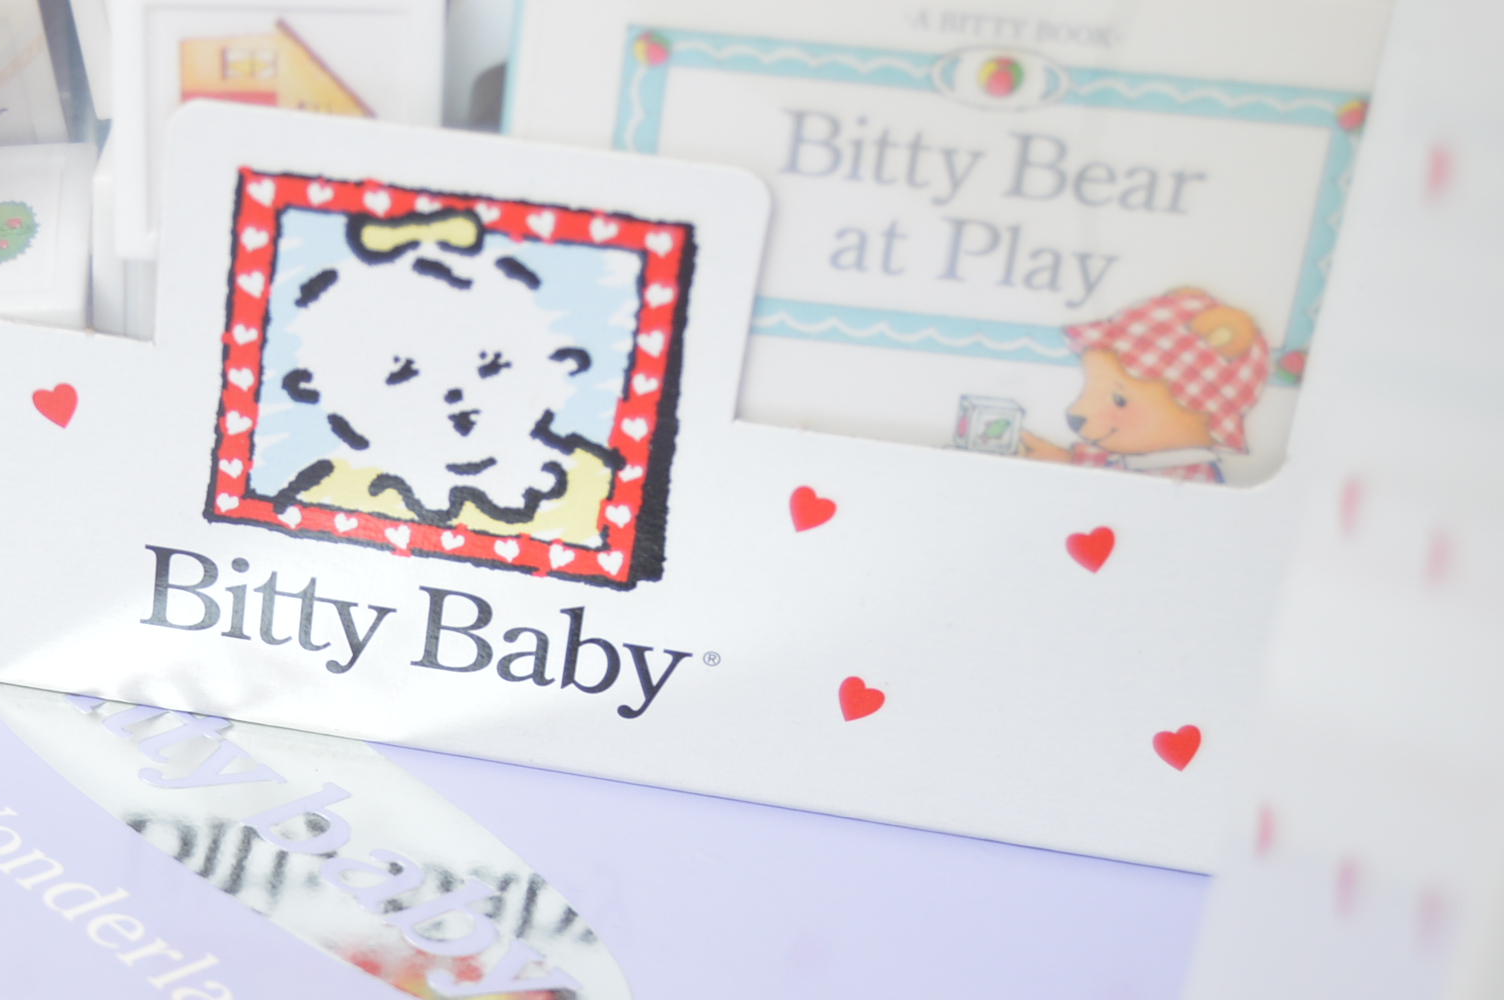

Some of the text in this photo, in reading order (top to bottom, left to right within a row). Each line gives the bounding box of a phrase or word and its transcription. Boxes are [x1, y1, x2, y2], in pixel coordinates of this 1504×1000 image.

[779, 107, 1209, 215] Bitty Bear
[829, 216, 1121, 309] at Play
[139, 543, 397, 674] Bitty
[239, 781, 585, 1000] baby
